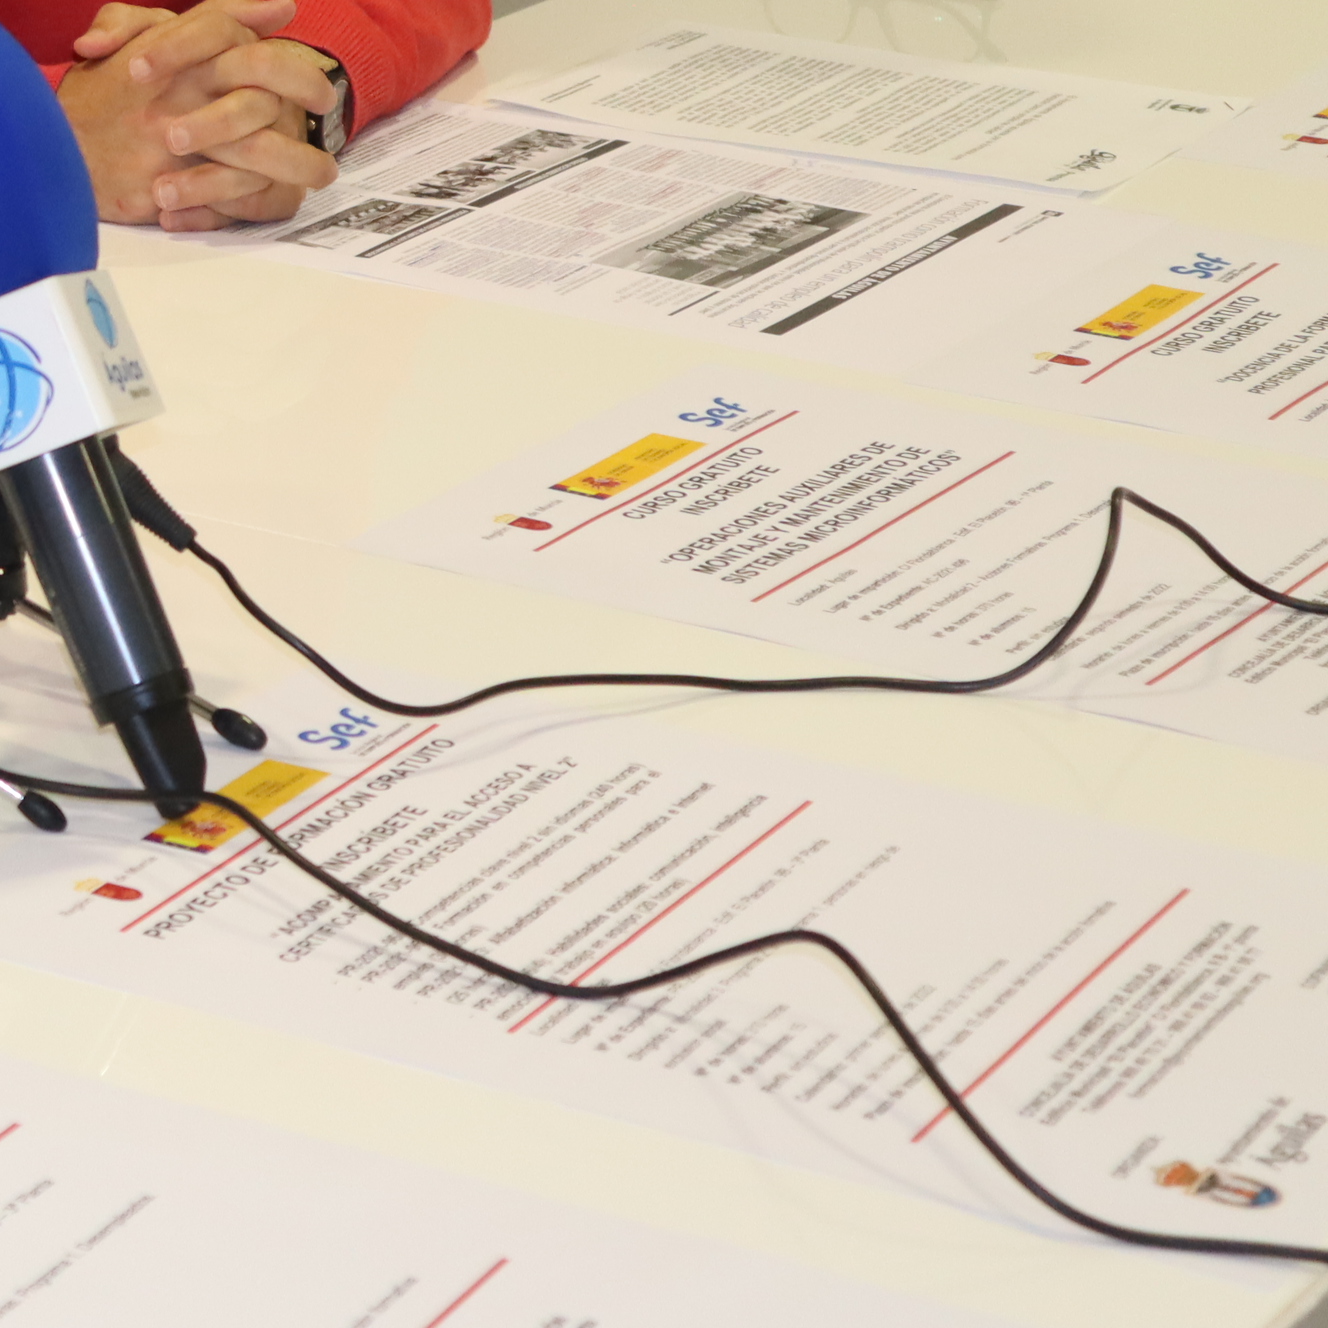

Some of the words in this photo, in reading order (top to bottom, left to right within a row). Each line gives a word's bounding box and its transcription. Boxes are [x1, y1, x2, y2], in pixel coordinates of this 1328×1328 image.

[1169, 252, 1231, 280] Sef
[1150, 331, 1204, 357] CURSO
[1192, 295, 1260, 333] GRATUITO
[1202, 310, 1281, 354] INSCRÍBETE
[1272, 342, 1301, 354] DE
[1286, 334, 1314, 344] LA
[1247, 355, 1325, 395] PROFESIONAL
[678, 396, 747, 428] Sef
[622, 489, 688, 520] CURSO
[677, 446, 763, 491] GRATUITO
[680, 464, 779, 516] INSCRÍBETE
[778, 453, 873, 503] AUXILIARES
[860, 441, 896, 455] DE
[692, 533, 779, 575] MONTAJE
[764, 524, 790, 534] Y
[779, 459, 908, 527] MANTENIMIENTO
[895, 446, 931, 461] DE
[721, 541, 810, 585] SISTEMAS
[297, 707, 378, 751] Sef
[378, 875, 412, 892] DE
[401, 793, 529, 877] PROFESIONALIDAD
[519, 768, 569, 794] NIVEL
[404, 821, 453, 847] PARA
[441, 809, 473, 822] EL
[463, 770, 524, 809] ACCESO
[143, 873, 251, 939] PROYECTO
[239, 855, 280, 876] DE
[366, 738, 455, 791] GRATUITO
